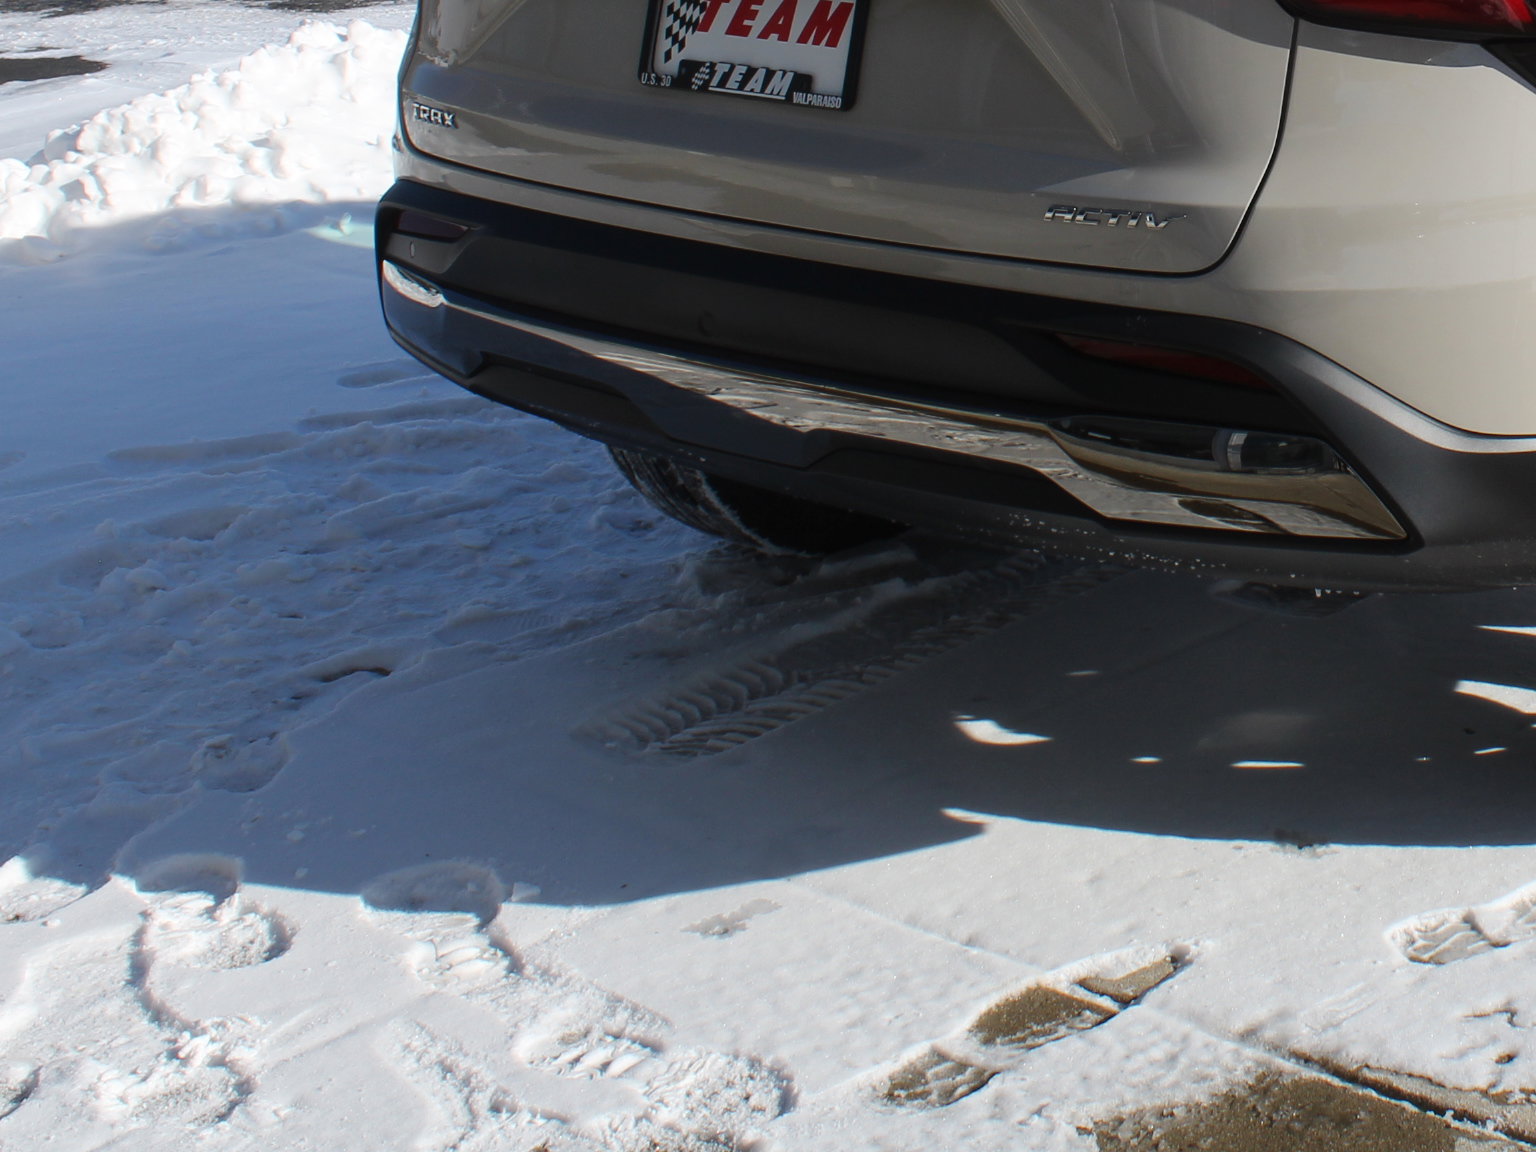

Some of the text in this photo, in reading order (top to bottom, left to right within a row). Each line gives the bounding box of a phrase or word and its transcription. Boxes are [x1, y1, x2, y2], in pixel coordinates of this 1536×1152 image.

[641, 71, 659, 87] U.S.
[709, 62, 795, 96] TEAM
[792, 91, 842, 109] VALPARAISO
[411, 102, 459, 128] TRAX
[1043, 204, 1187, 230] ACTIV
